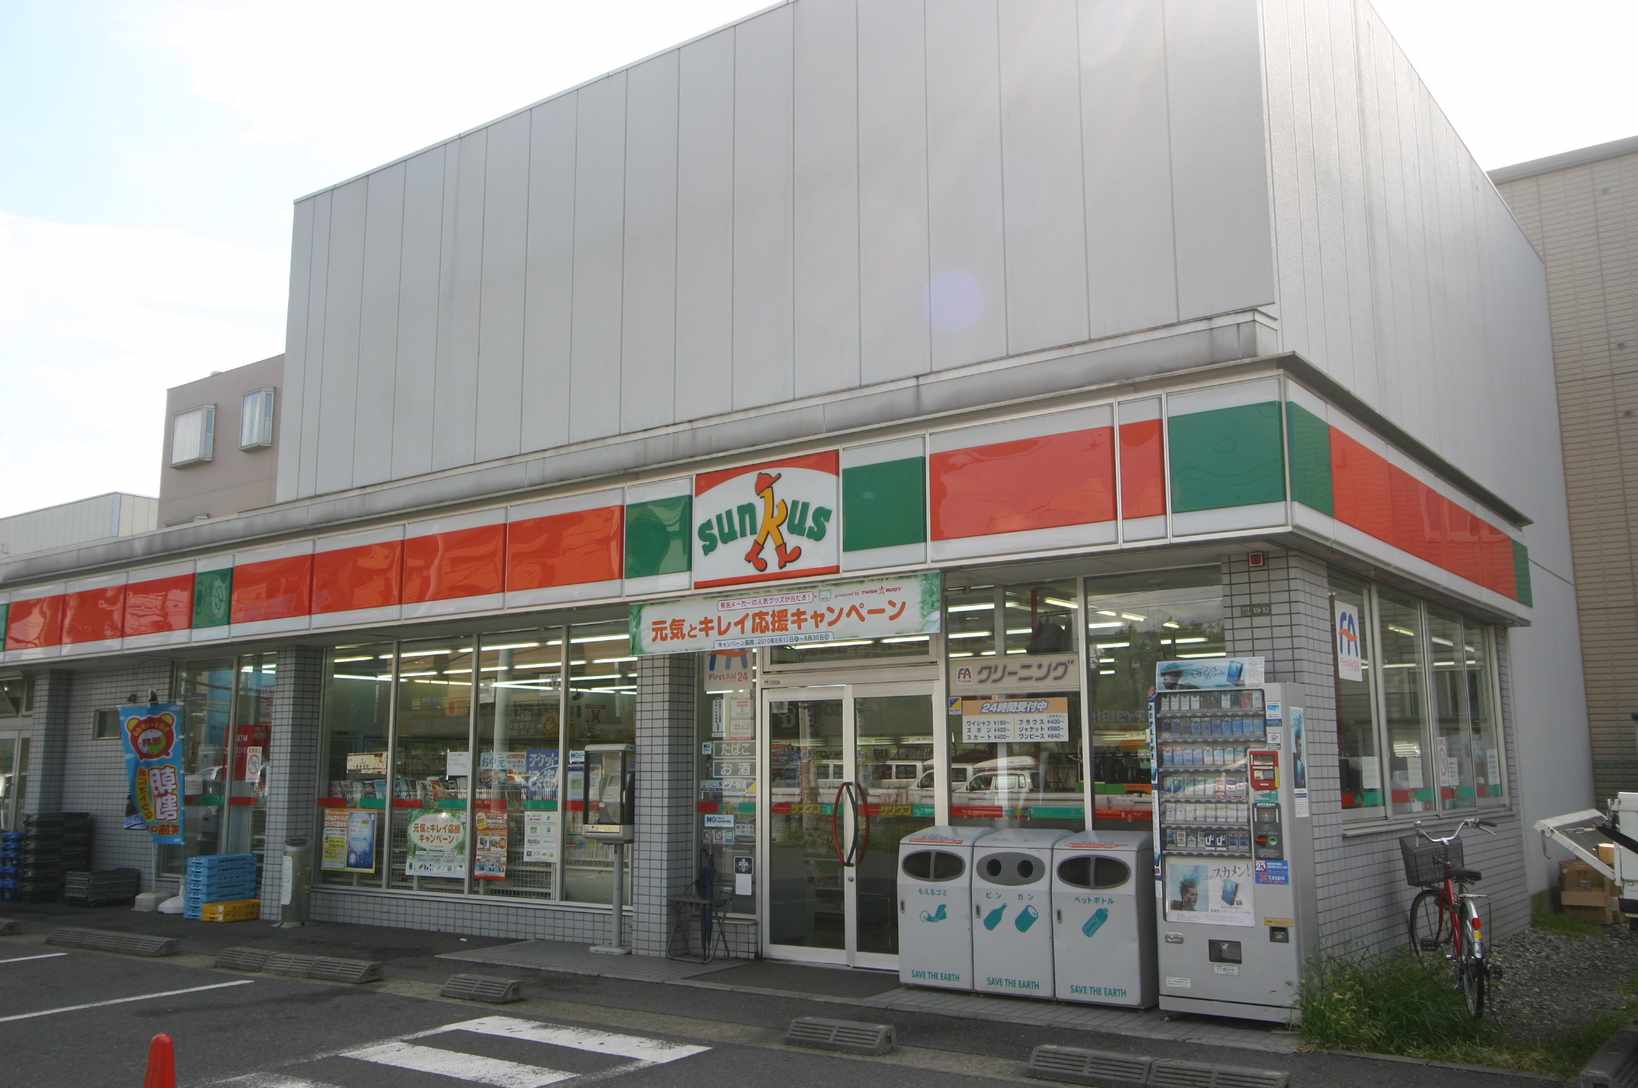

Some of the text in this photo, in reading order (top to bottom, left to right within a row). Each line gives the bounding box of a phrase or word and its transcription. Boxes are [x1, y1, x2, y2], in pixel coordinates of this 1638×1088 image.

[651, 599, 907, 643] 元気とキレイ応援キャンペーン
[977, 660, 1075, 683] クリーニング
[981, 701, 1048, 713] 24時間受付中
[1017, 894, 1034, 902] カン
[1074, 896, 1115, 905] ペットボトル
[911, 969, 960, 982] SAVE THE EARTH
[987, 976, 1040, 990] SAVE THE EARTH
[1070, 984, 1127, 998] SAVE THE EARTH
